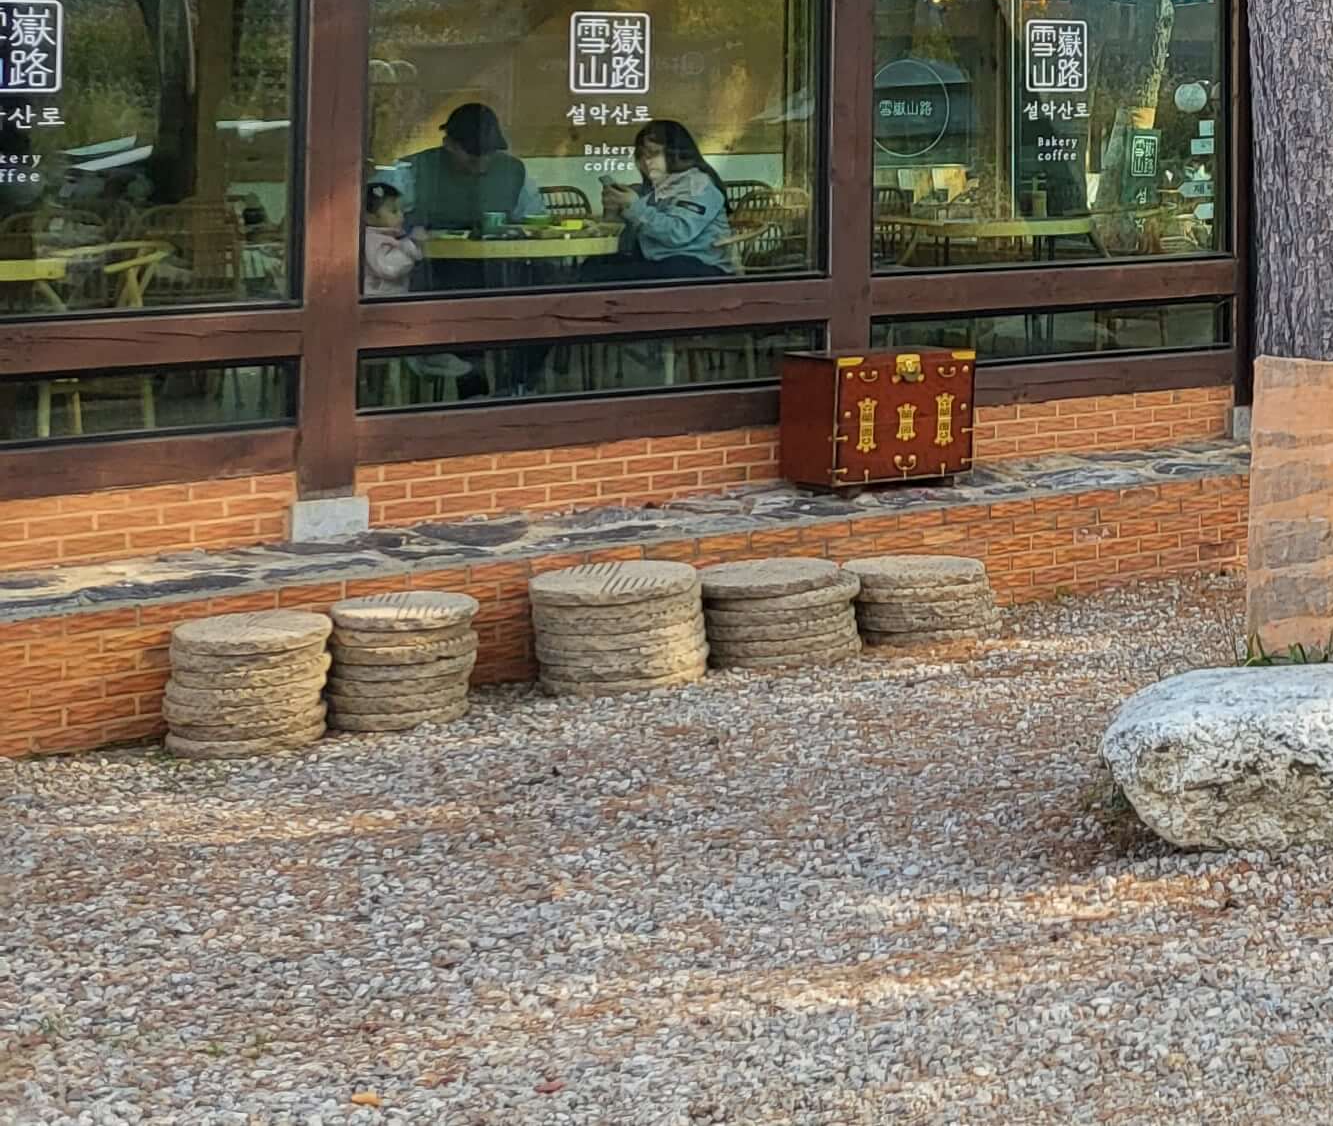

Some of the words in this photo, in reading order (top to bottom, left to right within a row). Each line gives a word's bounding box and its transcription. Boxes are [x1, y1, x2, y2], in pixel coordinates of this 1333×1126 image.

[0, 104, 66, 129] 산로
[566, 103, 653, 125] 설악산로
[1023, 100, 1091, 121] 설악산로
[584, 142, 636, 159] Bakery
[1037, 136, 1078, 149] Bakery
[1037, 149, 1077, 161] coffee
[584, 158, 635, 171] coffee
